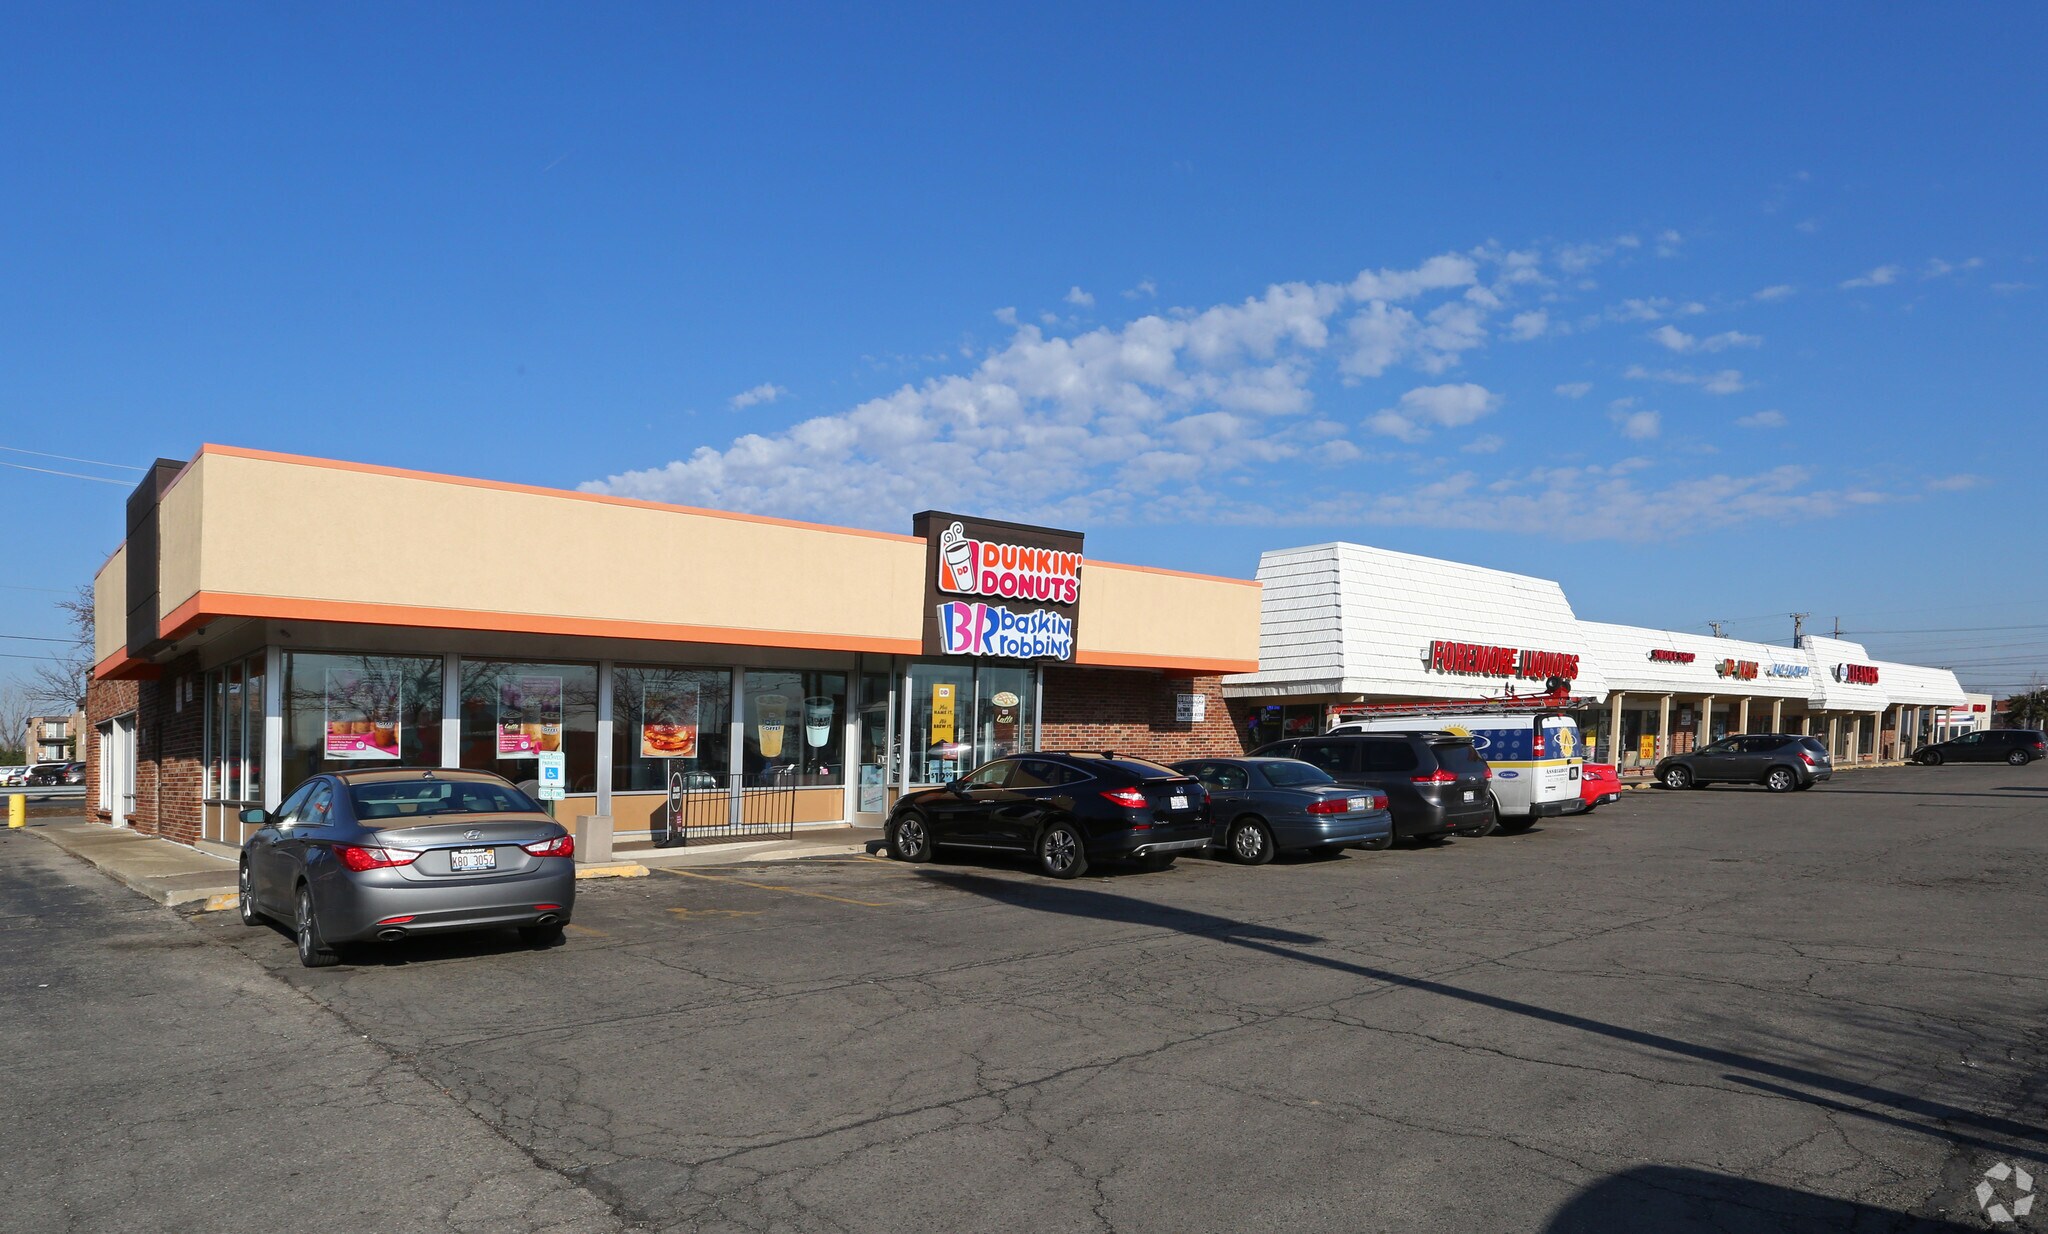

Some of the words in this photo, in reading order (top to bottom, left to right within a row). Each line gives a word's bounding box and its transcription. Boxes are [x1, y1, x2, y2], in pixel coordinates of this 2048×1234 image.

[957, 565, 969, 576] DD
[983, 544, 1082, 577] DUNKIN'
[982, 570, 1077, 602] DONUTS
[943, 601, 1000, 653] BR
[1431, 641, 1518, 675] FOREMORE
[1521, 650, 1580, 681] LIQUORS
[1653, 649, 1677, 661] SMOKE
[1678, 652, 1696, 663] SHOP
[1848, 664, 1879, 684] CLEANERS
[473, 854, 494, 866] 3052
